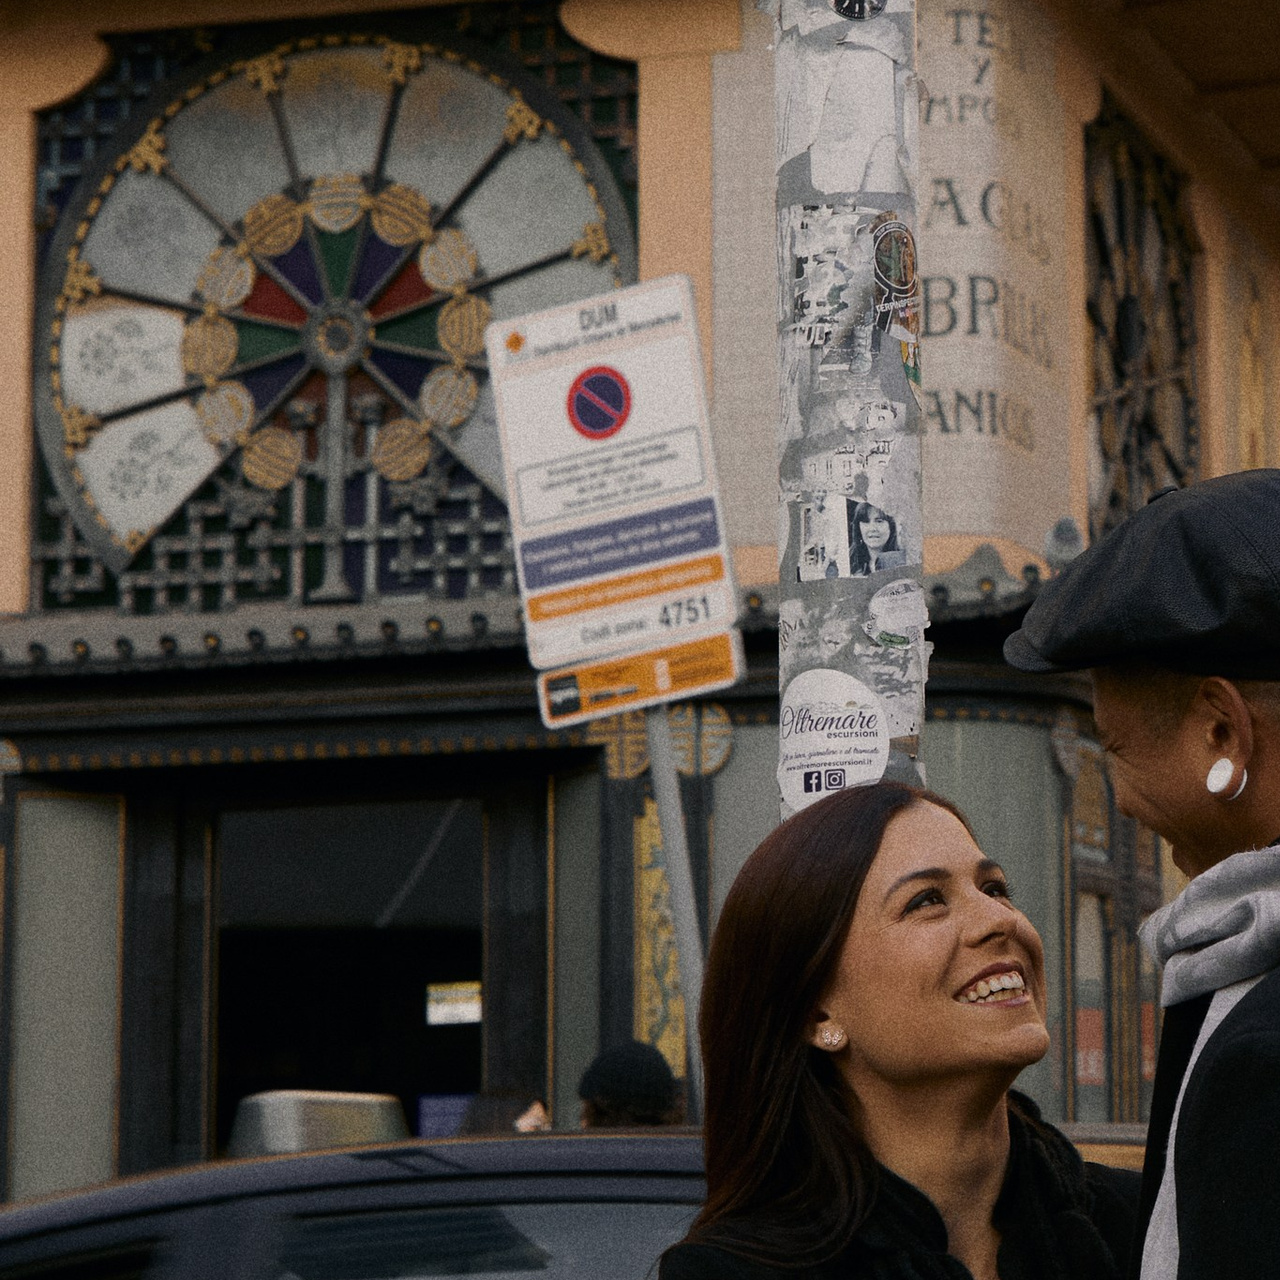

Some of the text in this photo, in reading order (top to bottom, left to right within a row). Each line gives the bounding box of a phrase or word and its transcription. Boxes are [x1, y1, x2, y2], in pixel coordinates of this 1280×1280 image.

[660, 596, 709, 626] 4751
[782, 706, 878, 740] Oltremare
[827, 729, 879, 739] escursioni
